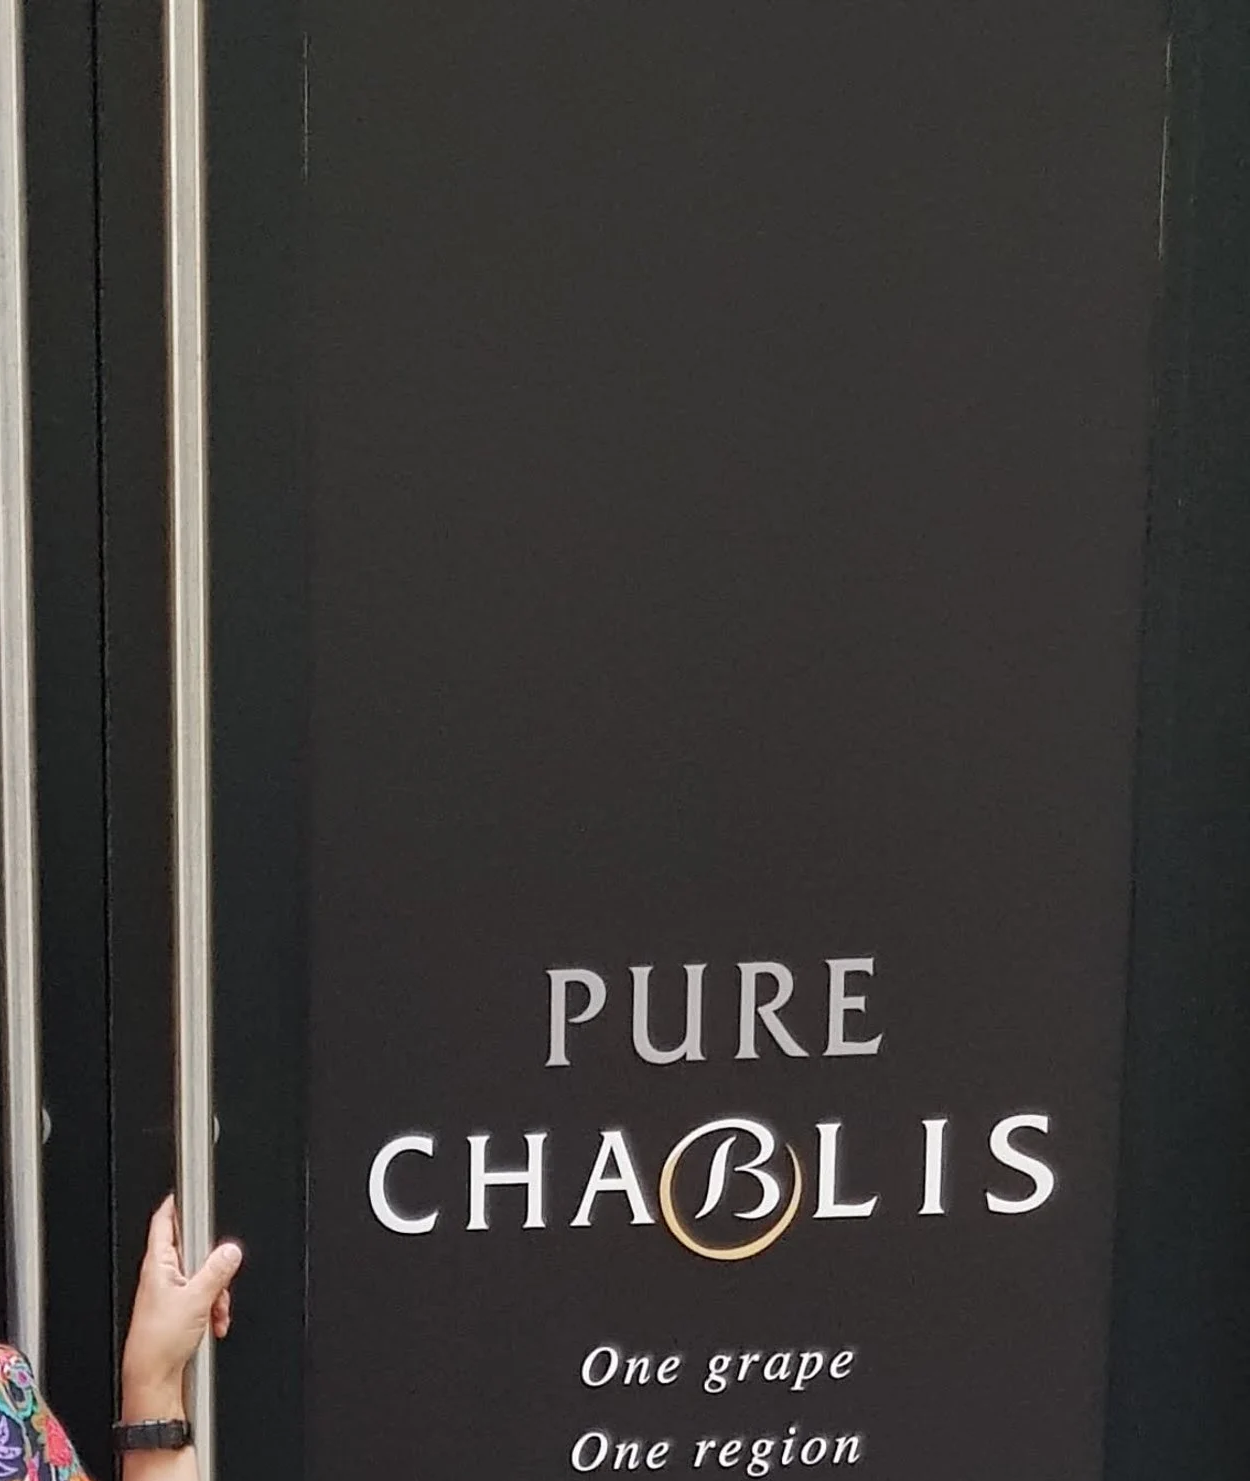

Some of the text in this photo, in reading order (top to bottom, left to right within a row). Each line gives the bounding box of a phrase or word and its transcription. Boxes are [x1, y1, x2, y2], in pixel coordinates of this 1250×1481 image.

[545, 957, 883, 1067] PURE
[368, 1113, 1055, 1261] CHABLIS
[581, 1346, 855, 1395] One grape
[571, 1425, 861, 1477] One region
